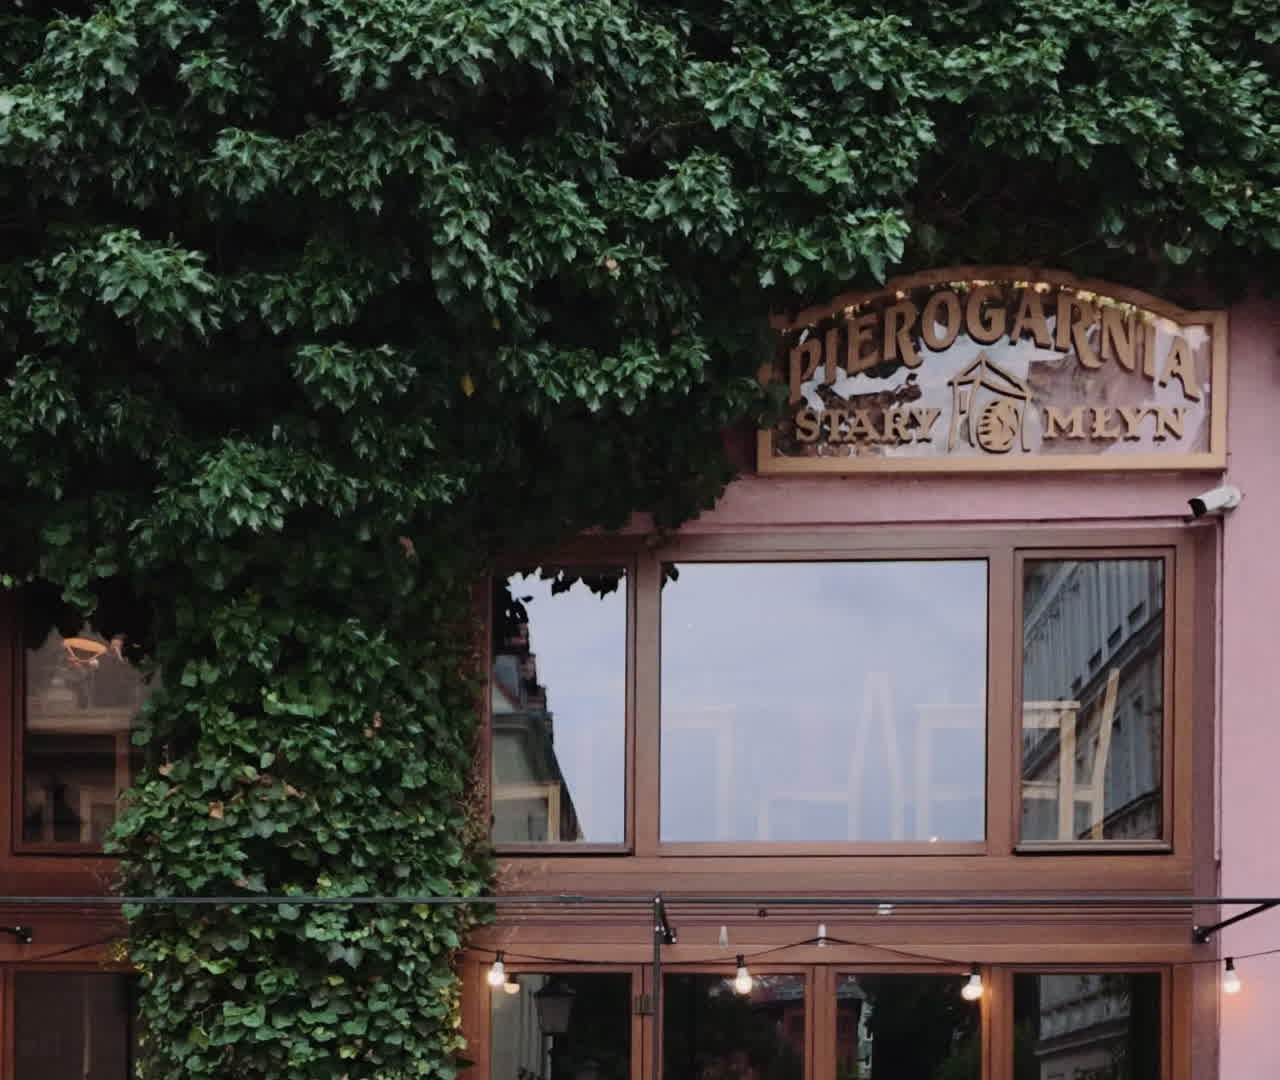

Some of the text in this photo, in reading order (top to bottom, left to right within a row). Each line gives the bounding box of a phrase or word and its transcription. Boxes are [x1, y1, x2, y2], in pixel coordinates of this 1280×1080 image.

[788, 287, 1201, 405] PIEROGARNIA
[794, 407, 1187, 444] STARY MŁYN
